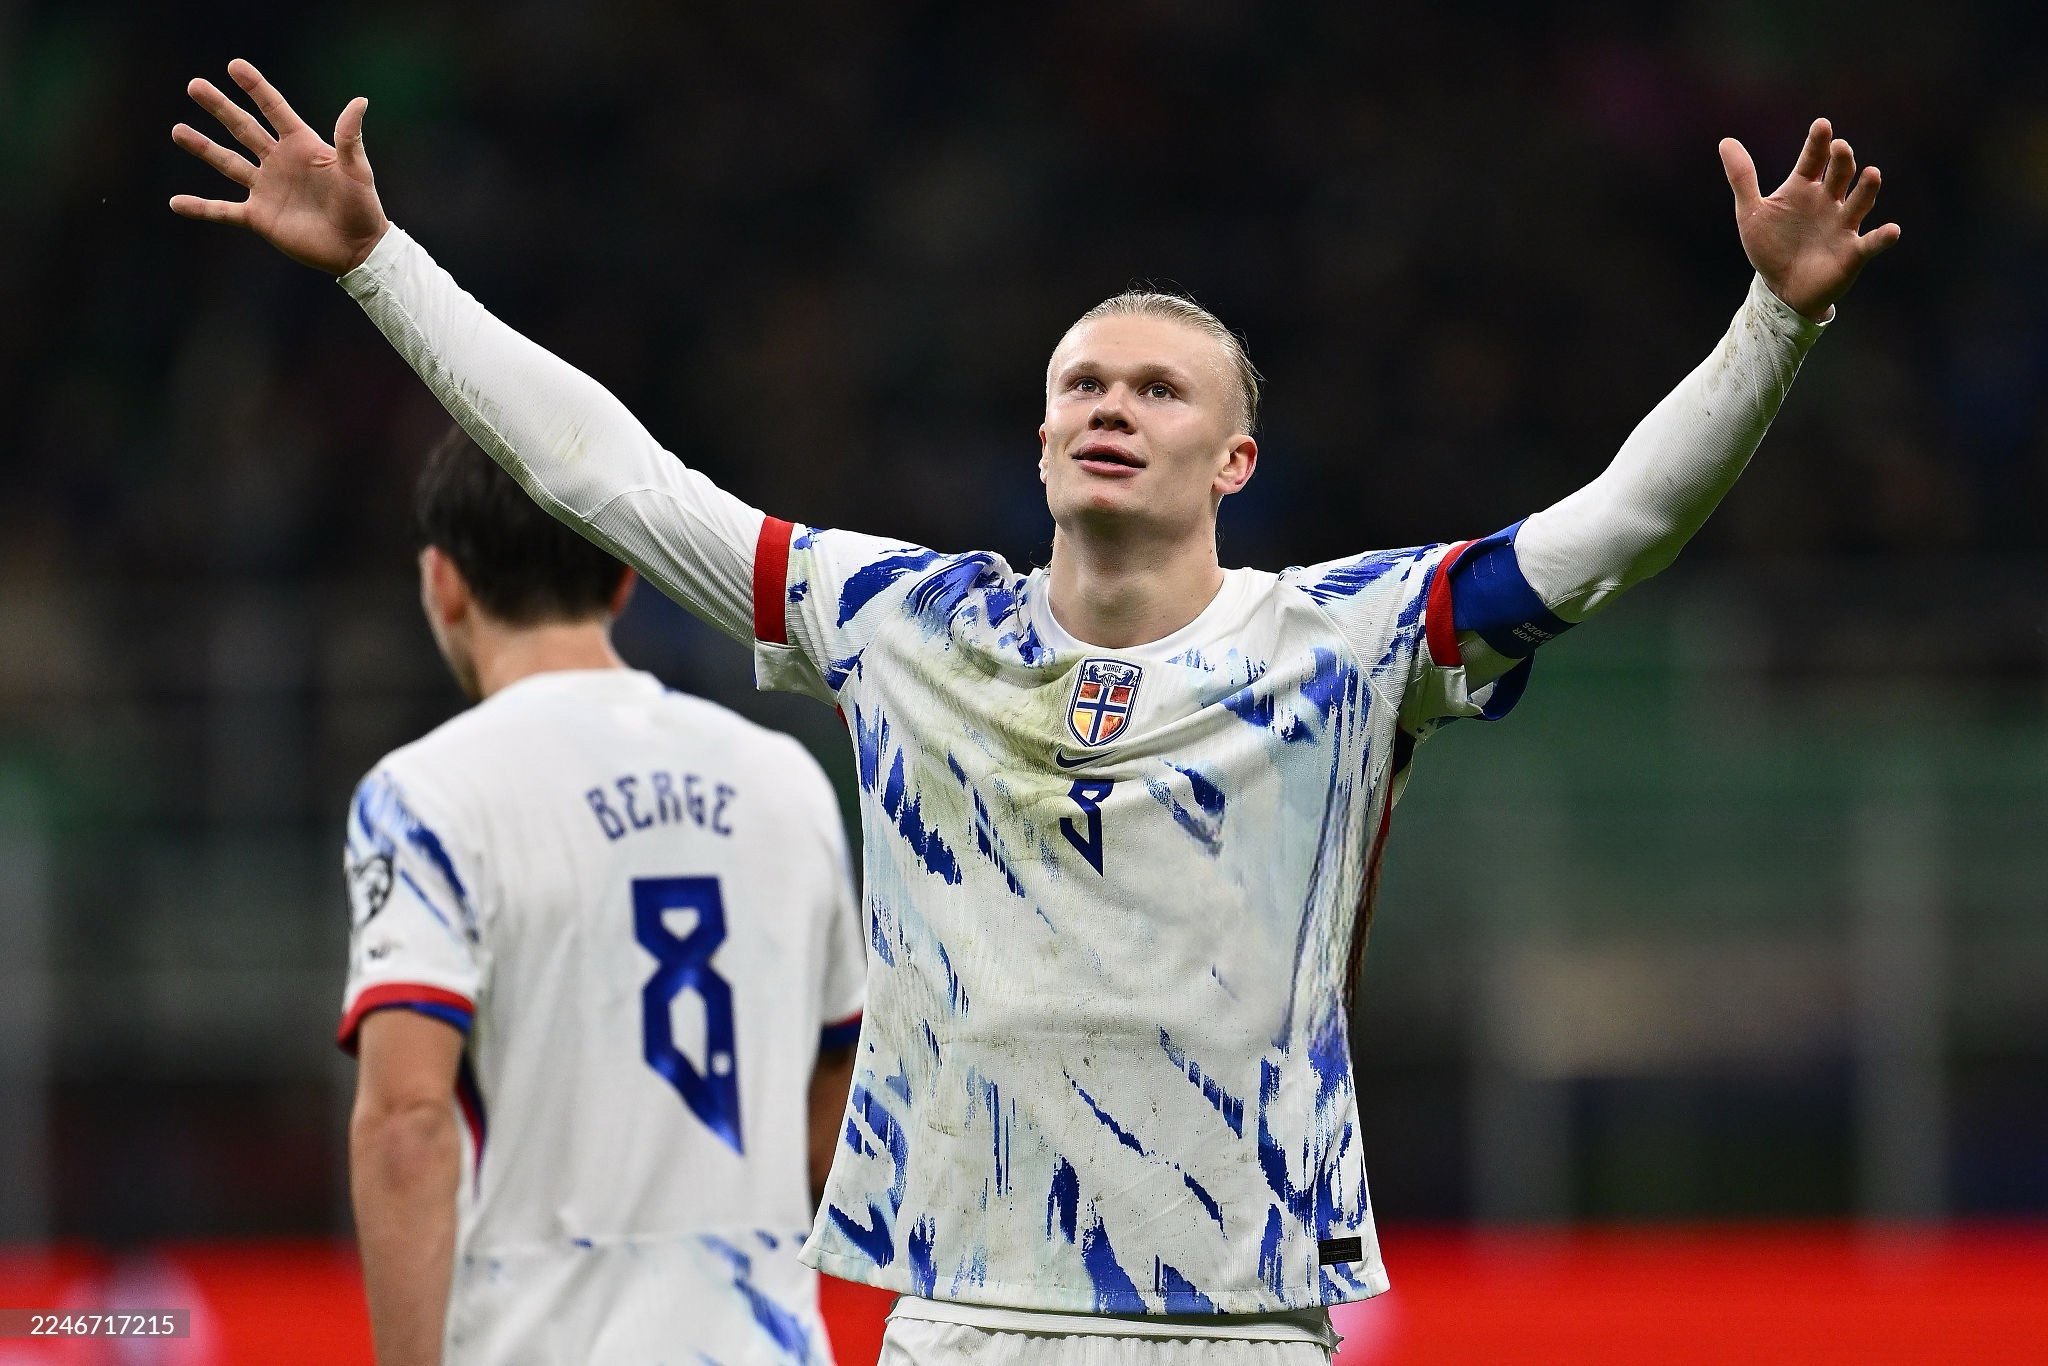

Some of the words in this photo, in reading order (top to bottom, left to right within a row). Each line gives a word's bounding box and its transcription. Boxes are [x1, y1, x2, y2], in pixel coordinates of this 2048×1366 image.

[1103, 663, 1123, 674] NORGE
[585, 771, 737, 841] BERGE
[1059, 778, 1115, 878] 9
[630, 875, 746, 1158] 8
